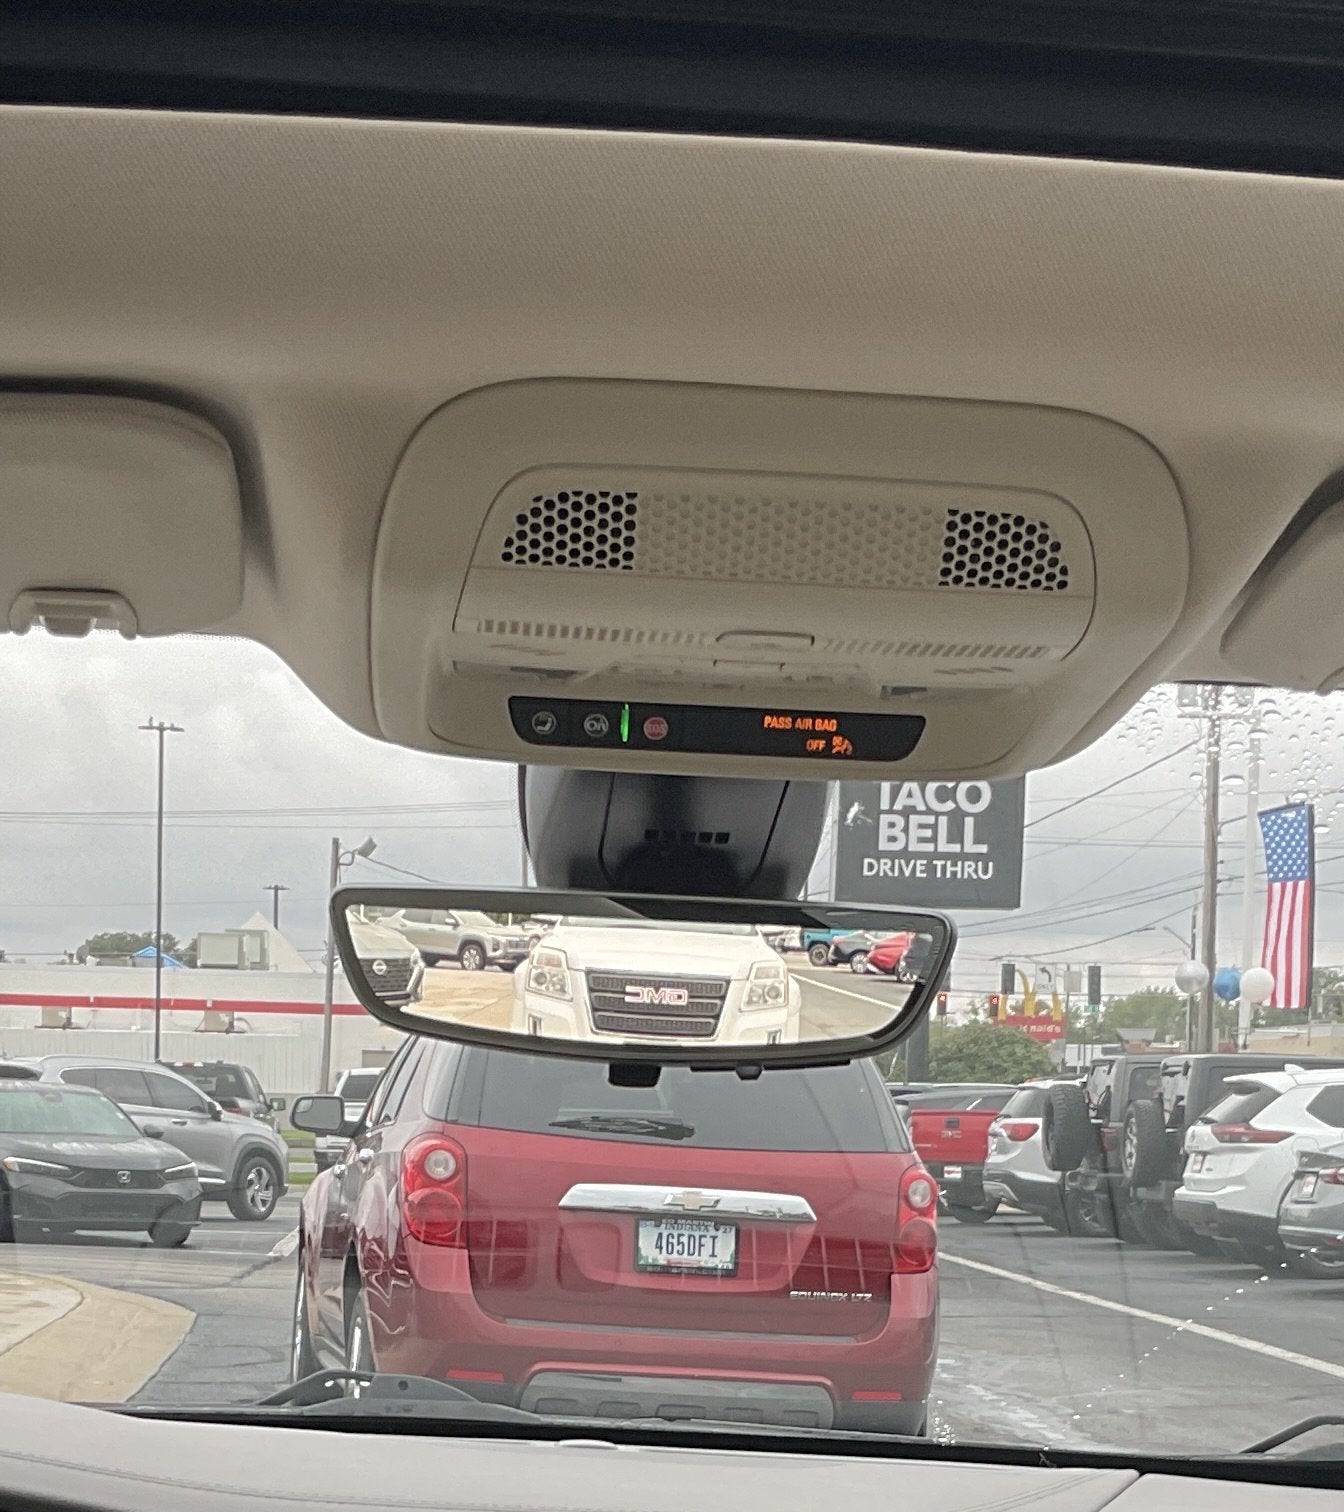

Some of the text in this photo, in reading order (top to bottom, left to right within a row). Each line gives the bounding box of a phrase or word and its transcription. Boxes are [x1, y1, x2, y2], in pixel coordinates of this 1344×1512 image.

[763, 714, 838, 732] PASS AIR BAG
[806, 737, 827, 753] OFF
[877, 781, 992, 814] TACO
[877, 814, 988, 854] BELL
[862, 857, 994, 881] DRIVE THRU
[664, 1223, 711, 1233] INDIANA
[655, 1231, 719, 1258] 465DFI
[789, 1291, 873, 1303] EQUINOX LTZ
